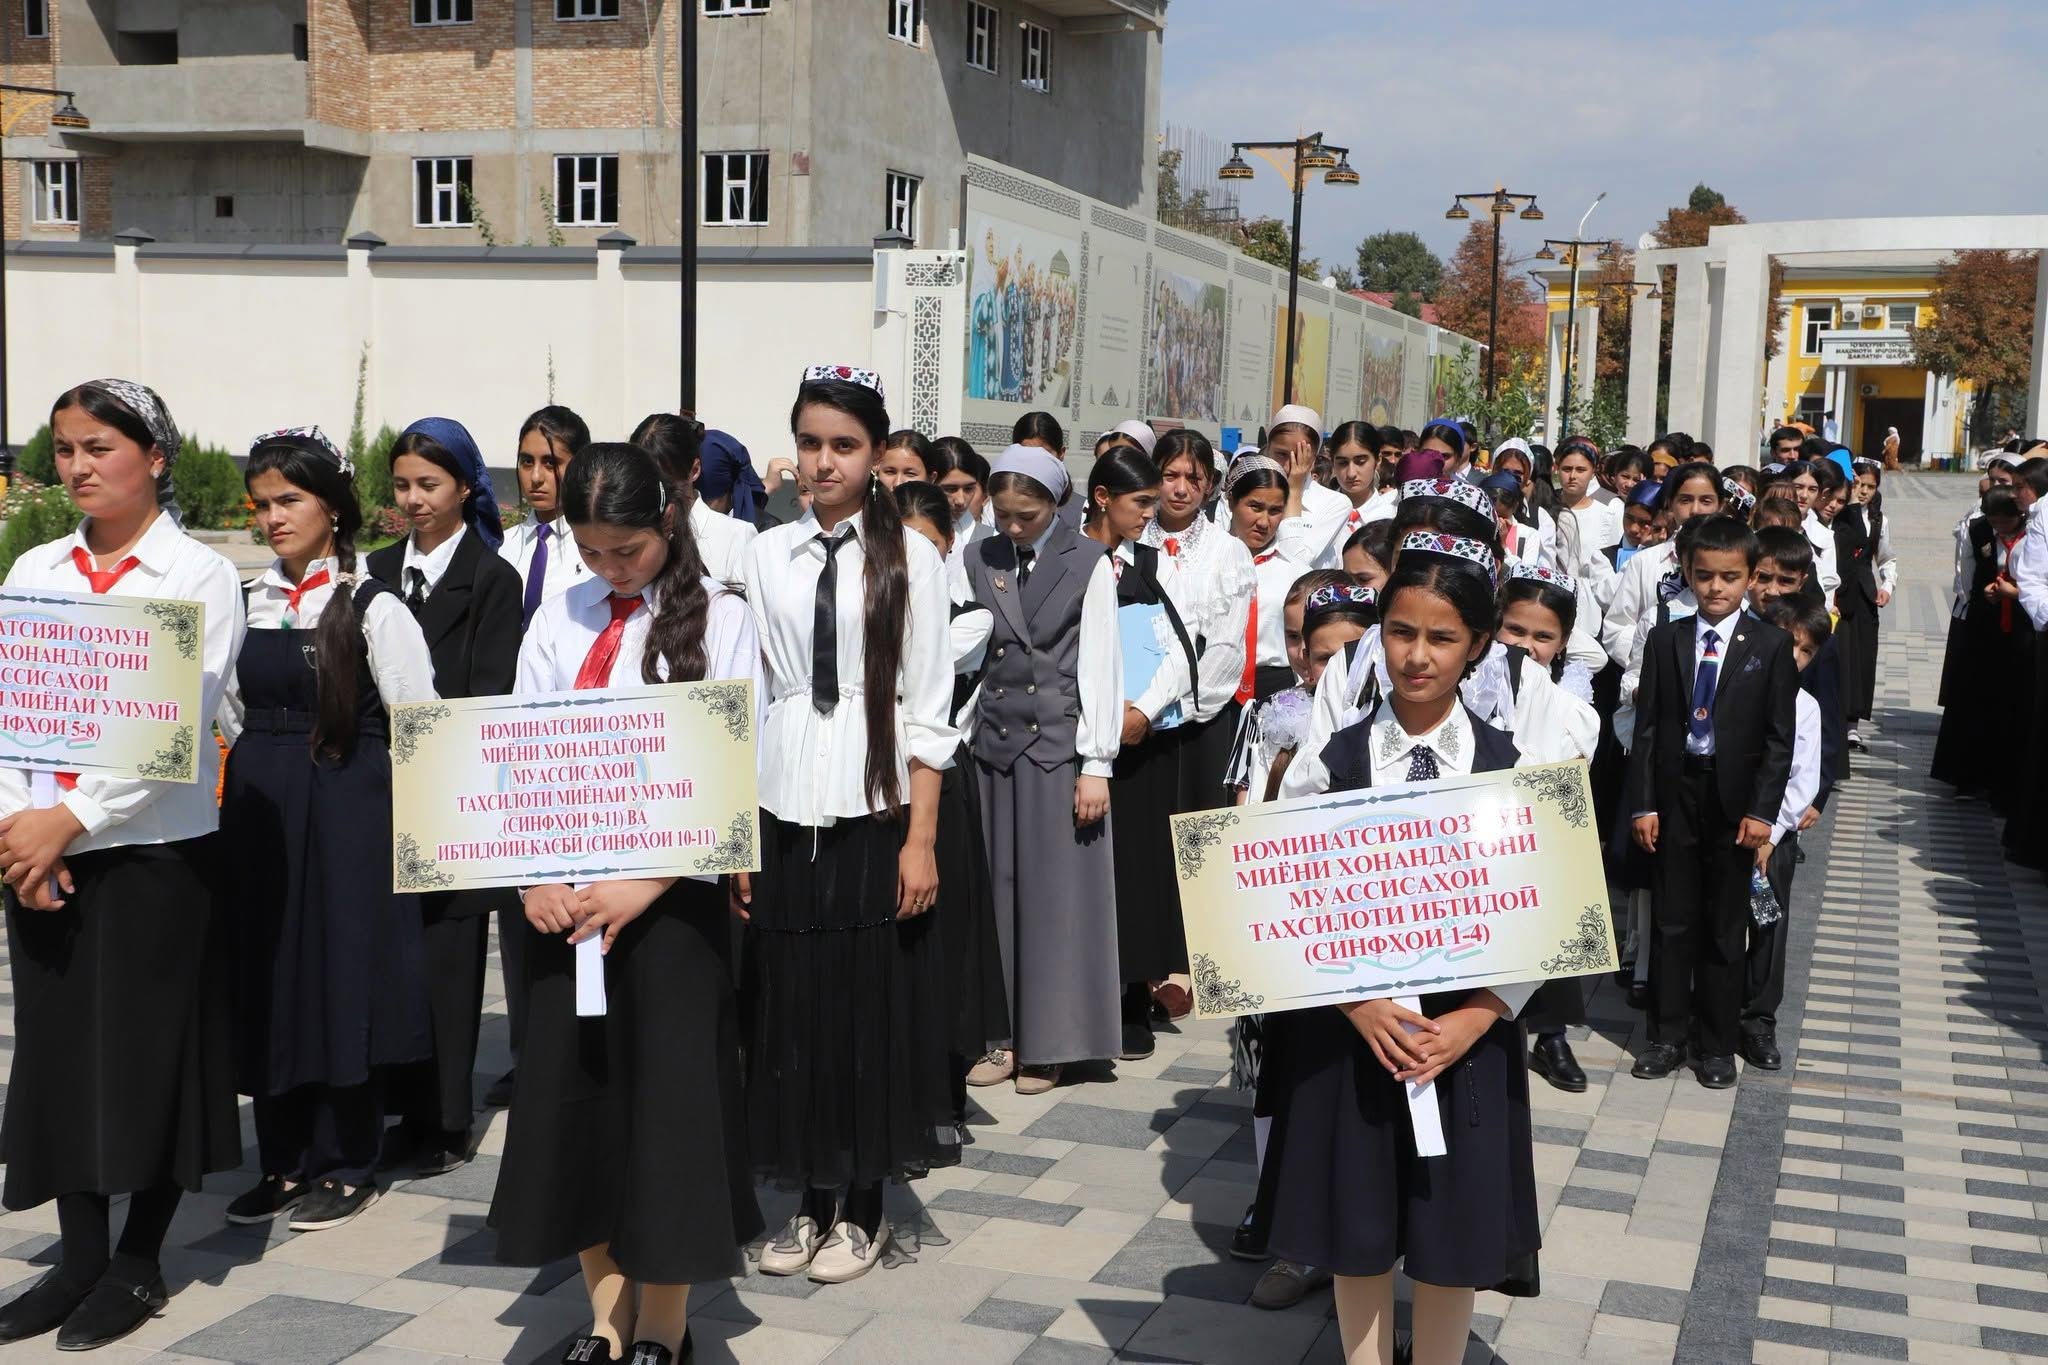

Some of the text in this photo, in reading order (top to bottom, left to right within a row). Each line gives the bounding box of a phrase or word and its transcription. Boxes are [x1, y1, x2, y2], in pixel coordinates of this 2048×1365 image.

[80, 626, 149, 648] ОЗМУН
[0, 643, 148, 671] ХОНАНДАГОНИ
[1, 667, 109, 692] ССИСАҲОИ
[10, 690, 96, 714] МИЁНАИ
[102, 699, 179, 721] УМУМӢ
[71, 720, 101, 742] 5-8)
[480, 712, 665, 740] НОМИНАТСИЯИ ОЗМУН
[482, 736, 665, 764] МИЁНИ ХОНАНДАГОНИ
[512, 762, 636, 786] МУАССИСАҲОИ
[457, 777, 693, 813] ТАҲСИЛОТИ МИЁНАИ УМУМӢ
[503, 809, 648, 836] (СИНФҲОИ 9-11) ВА
[1232, 818, 1434, 864] НОМИНАТСИЯИ
[1440, 806, 1534, 836] ОЗУН
[530, 833, 582, 856] КАСБӢ
[586, 831, 672, 855] (СИНФҲОИ
[678, 829, 716, 847] 10-11)
[1236, 833, 1537, 890] МИЁНИ ХОНАНДАГОНИ
[1289, 867, 1490, 909] МУАССИСАҲОИ
[1249, 885, 1540, 943] ТАҲСИЛОТИ ИБТИДОӢ
[1304, 922, 1491, 966] (СИНФҲОИ 1-4)
